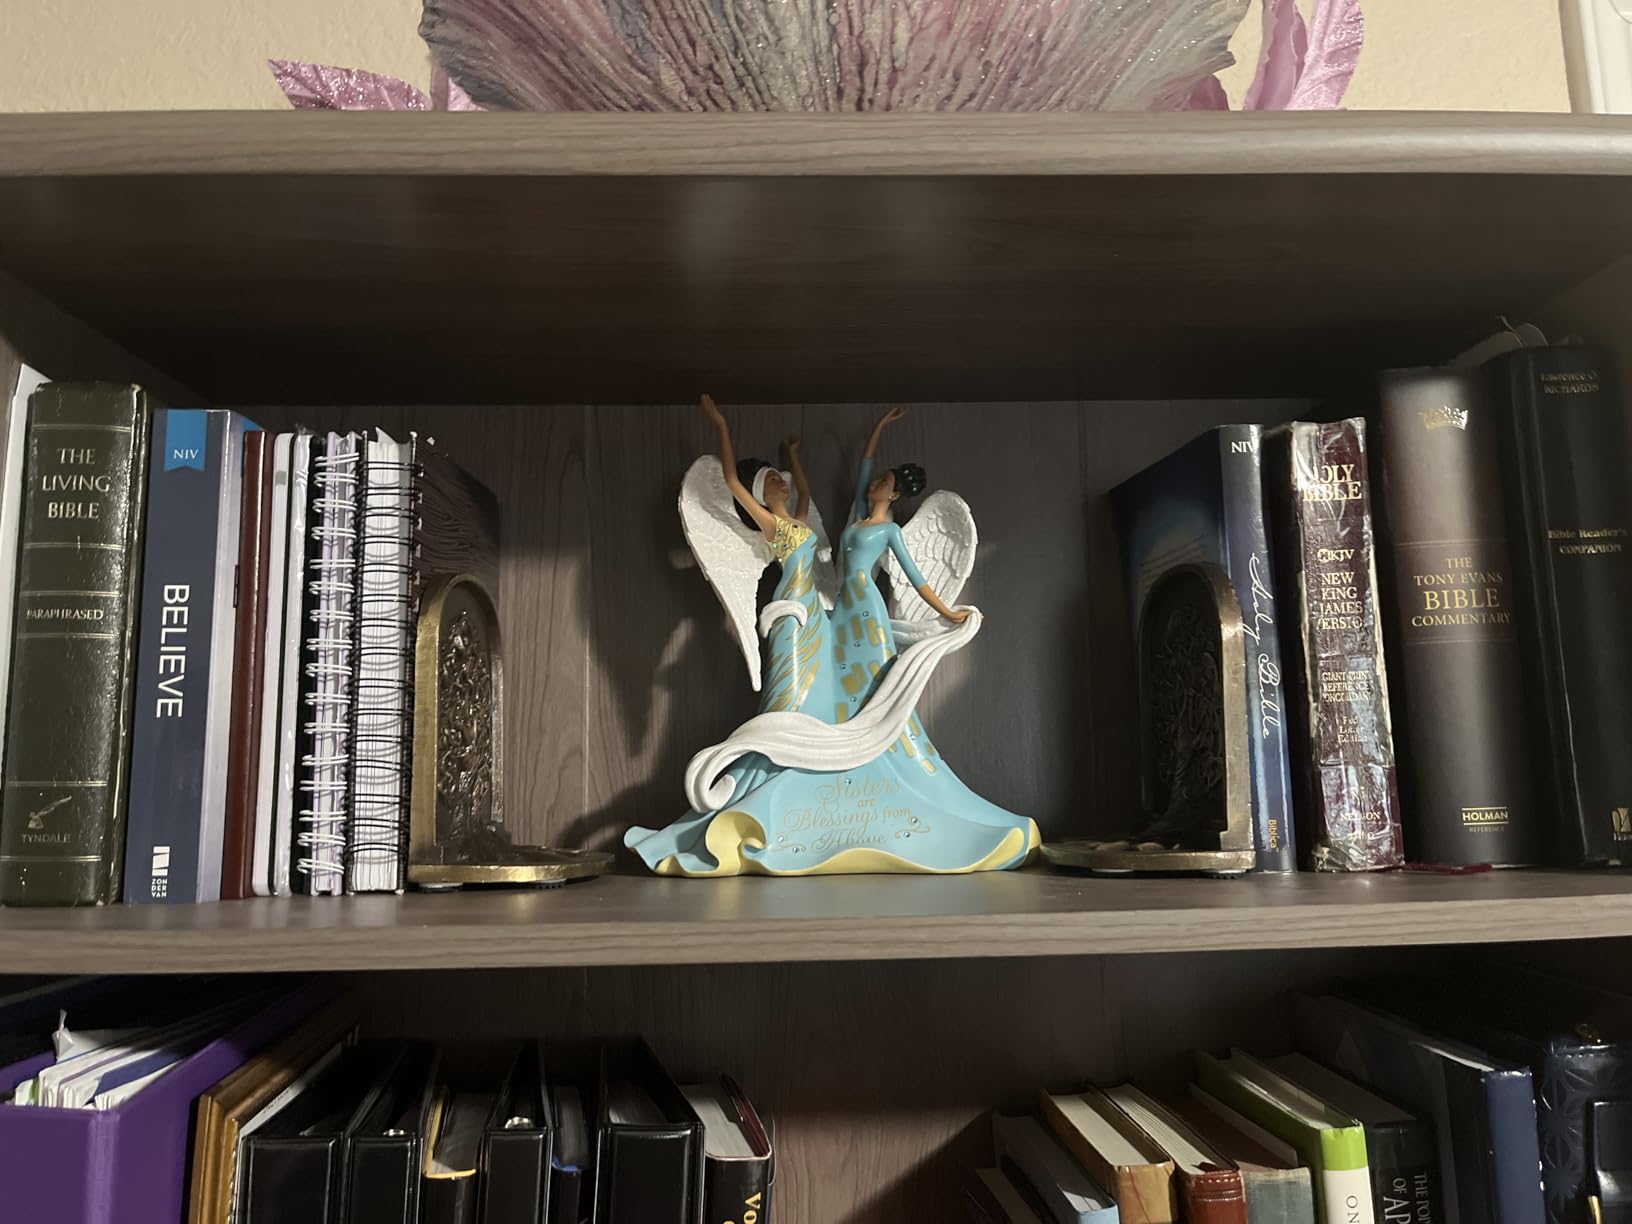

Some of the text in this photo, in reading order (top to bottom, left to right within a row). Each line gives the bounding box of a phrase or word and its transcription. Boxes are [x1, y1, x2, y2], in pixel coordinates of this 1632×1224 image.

[173, 448, 199, 460] NIV
[1231, 441, 1257, 453] NIV
[57, 448, 96, 465] THE
[42, 474, 111, 493] LIVING
[48, 501, 100, 519] BIBLE
[1559, 543, 1622, 554] COMPANION
[1446, 557, 1473, 569] THE
[1320, 571, 1355, 585] NEW
[1413, 572, 1503, 586] TONY EVANS
[1321, 586, 1358, 600] KING
[1423, 588, 1500, 611] BIBLE
[26, 607, 104, 620] PARAPHRASED
[1319, 601, 1363, 617] JAMES
[1411, 612, 1511, 628] COMMENTARY
[156, 584, 190, 719] BELIEVE
[1258, 653, 1280, 738] Bible
[1340, 811, 1381, 822] NELON
[1462, 811, 1508, 821] HOLMAN
[22, 832, 71, 844] TYNDALE
[1392, 1177, 1407, 1194] OF
[1414, 1171, 1428, 1198] THE
